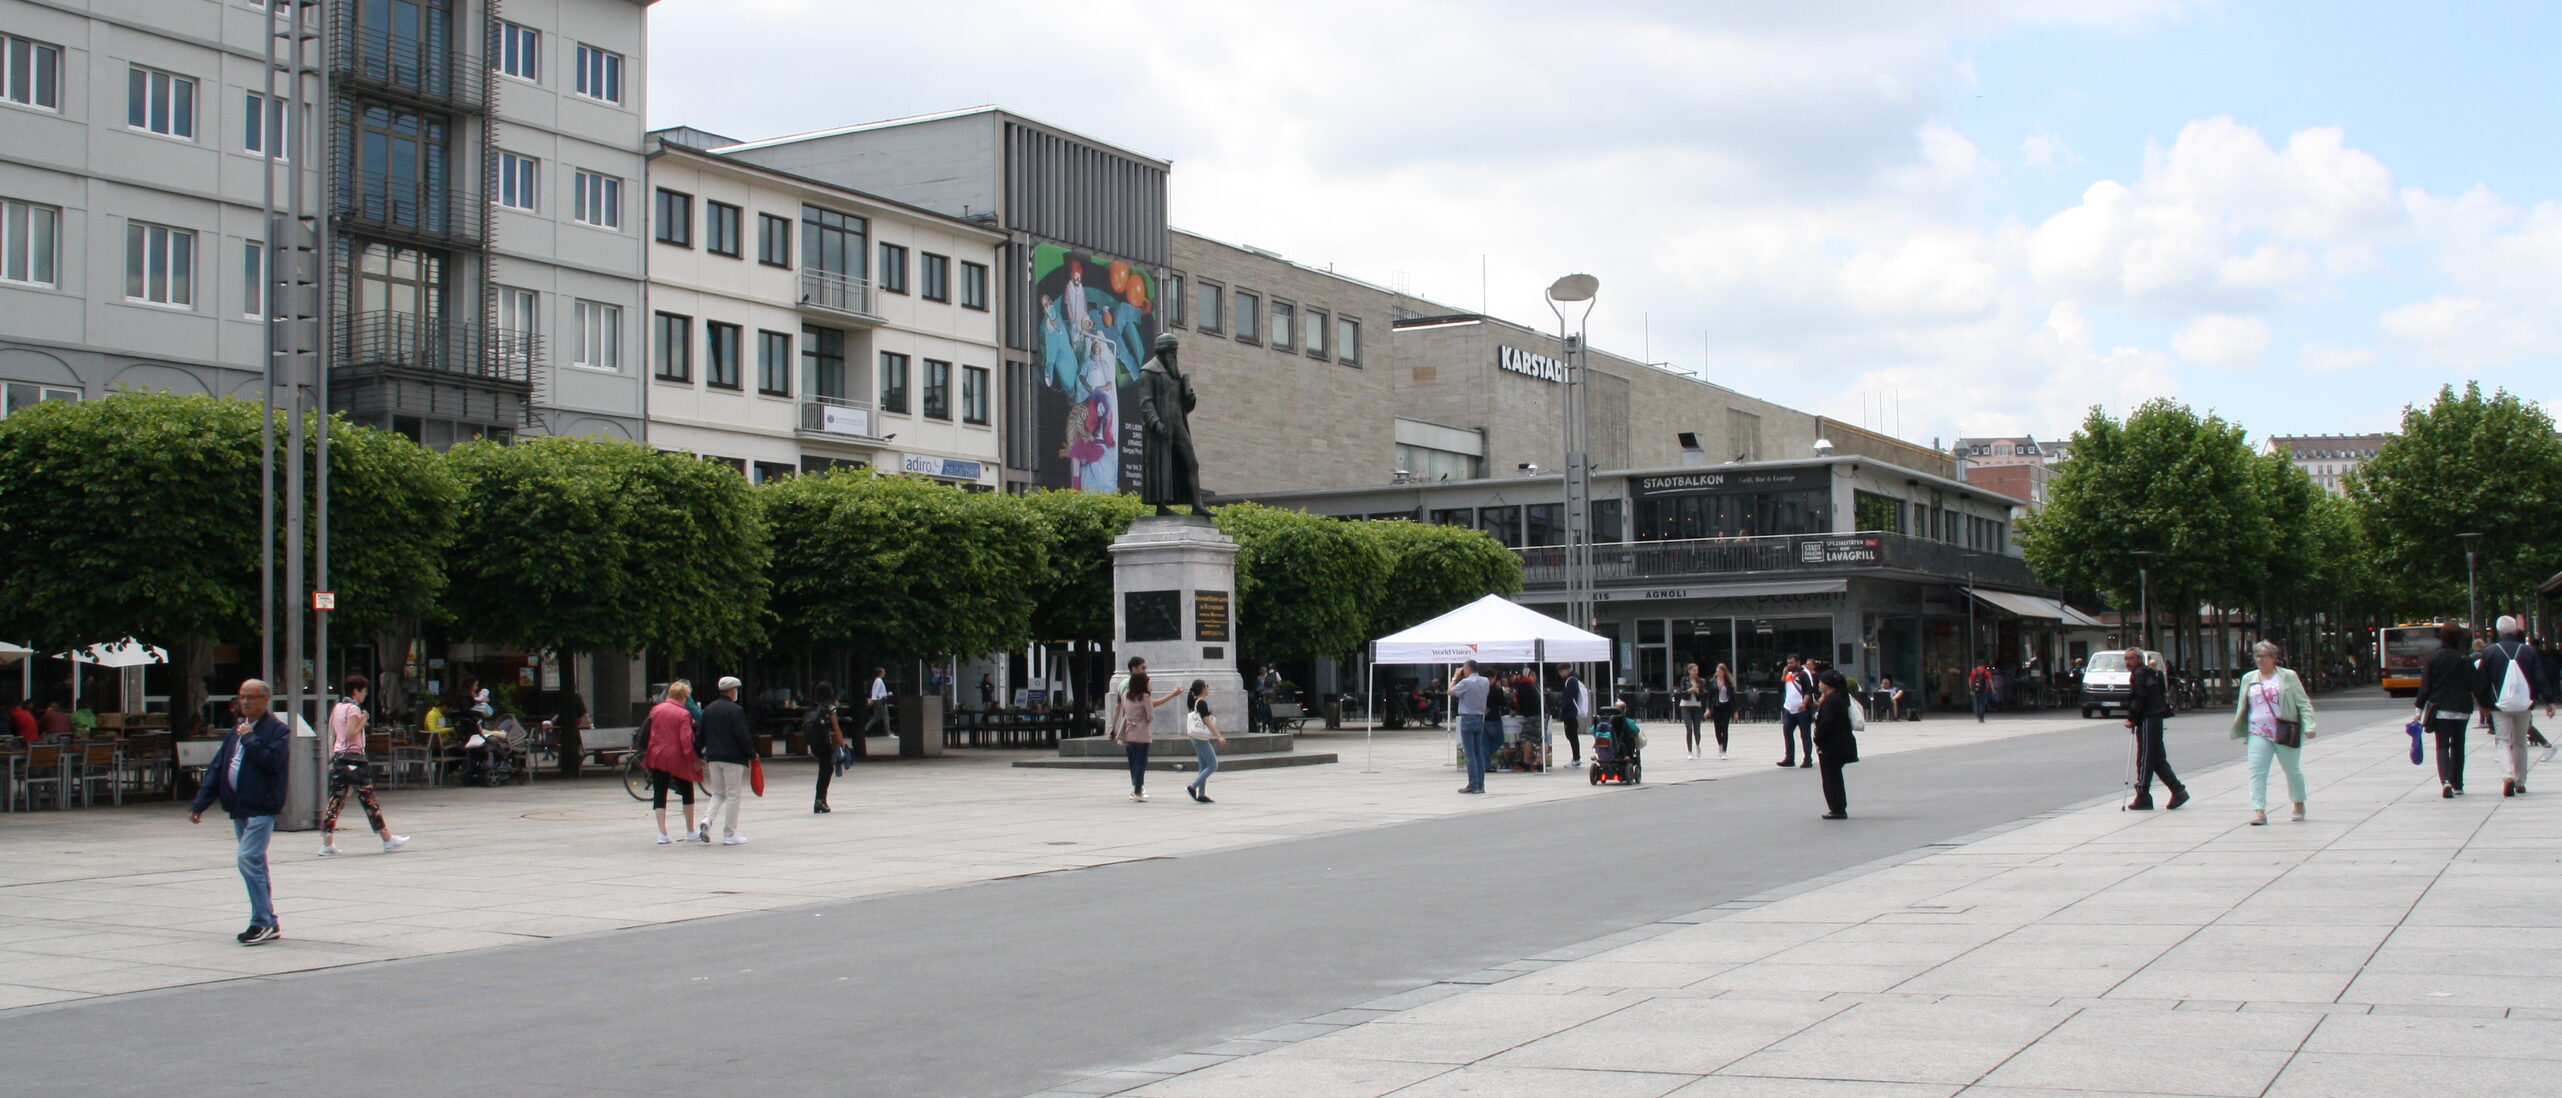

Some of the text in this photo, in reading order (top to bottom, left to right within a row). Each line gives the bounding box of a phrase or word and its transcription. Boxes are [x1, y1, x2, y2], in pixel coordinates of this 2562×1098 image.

[1643, 474, 1724, 489] STADTBALKON
[1826, 550, 1875, 561] LAVAGRILL
[1645, 589, 1687, 599] AGNOLI
